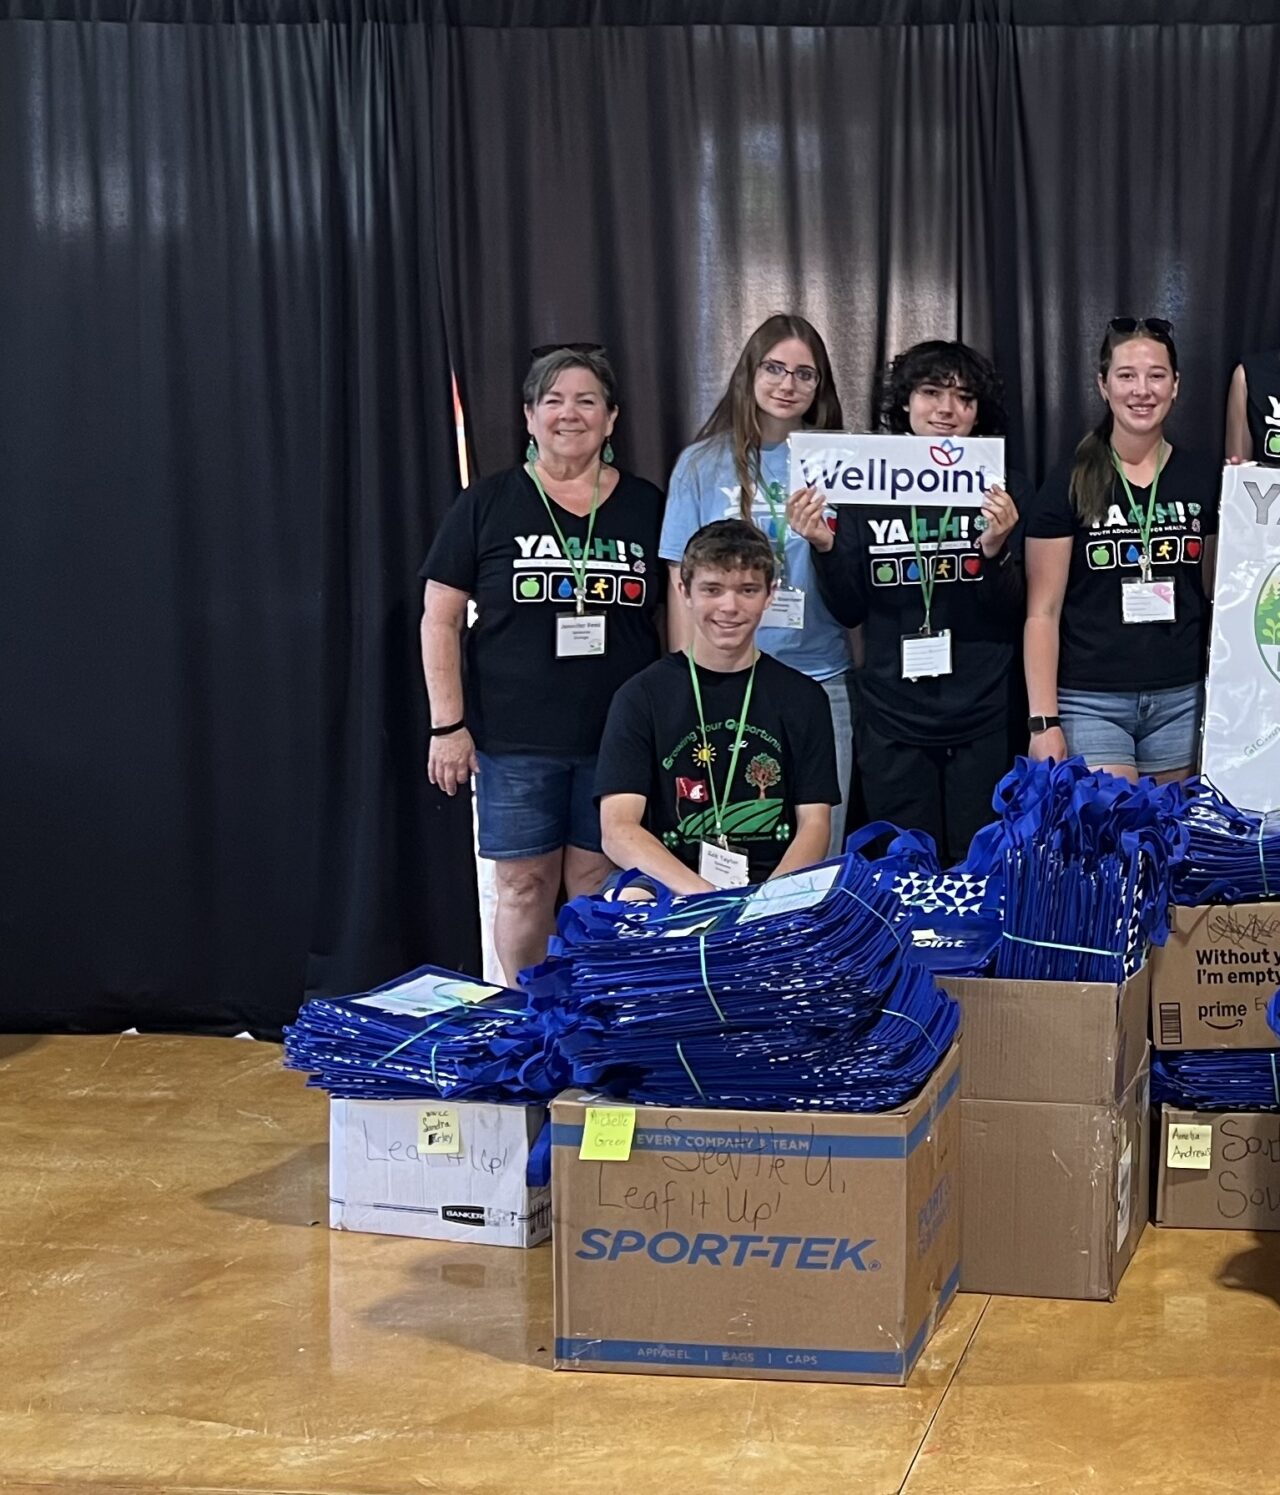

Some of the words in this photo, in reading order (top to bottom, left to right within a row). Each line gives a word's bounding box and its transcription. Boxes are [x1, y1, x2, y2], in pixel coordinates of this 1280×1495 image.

[800, 458, 991, 500] Wellpoint
[1196, 948, 1271, 966] Without
[1197, 968, 1225, 985] I'm
[1198, 1001, 1247, 1021] prime
[594, 1132, 626, 1147] Green
[637, 1134, 682, 1147] EVERY
[685, 1135, 754, 1150] COMPANY
[771, 1139, 810, 1152] TEAM
[599, 1160, 678, 1229] Leaf
[575, 1228, 878, 1273] SPORT-TEK
[637, 1346, 692, 1360] APPAREL
[722, 1351, 755, 1363] BAGS
[785, 1354, 819, 1366] CAPS
